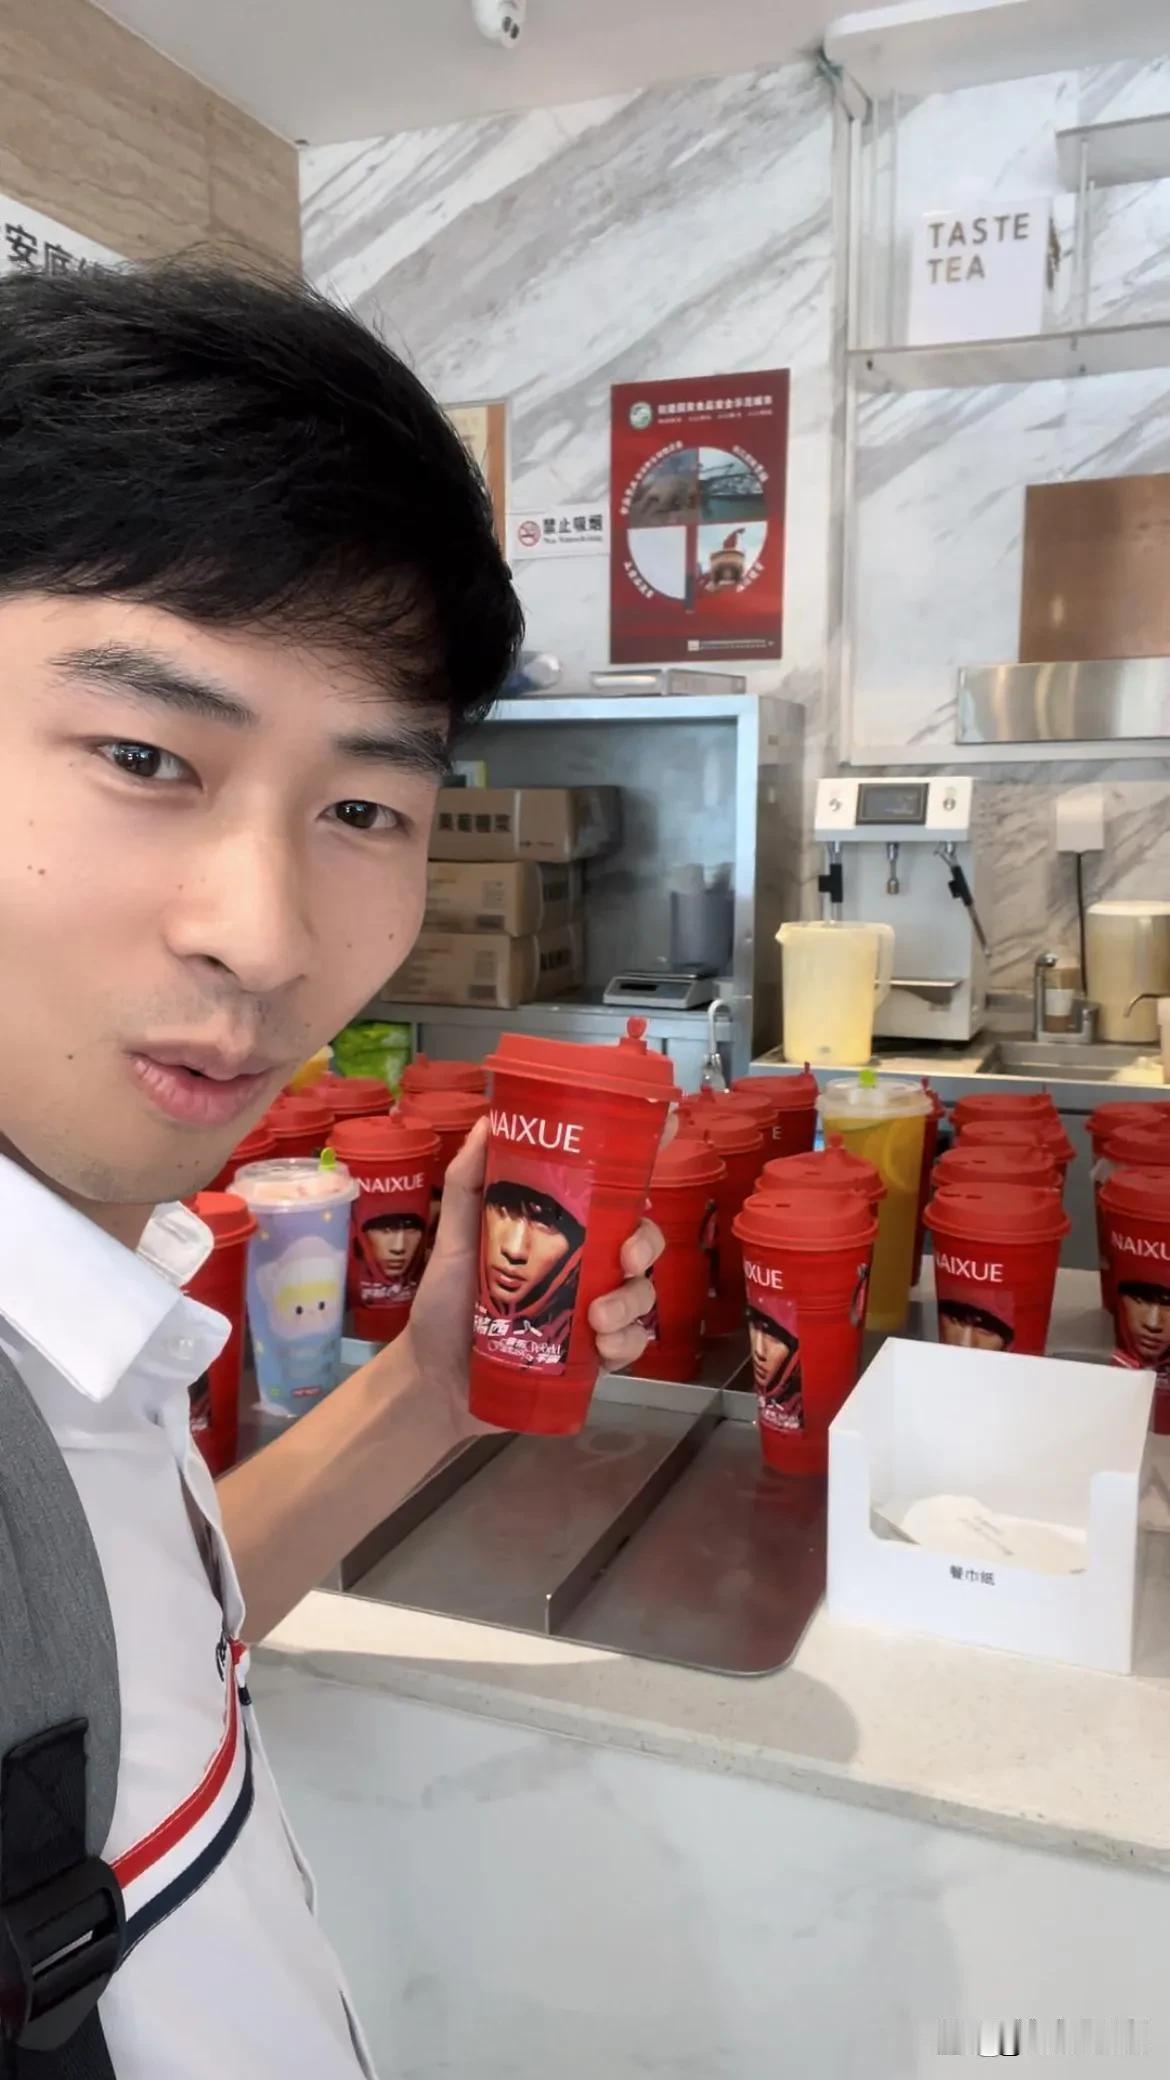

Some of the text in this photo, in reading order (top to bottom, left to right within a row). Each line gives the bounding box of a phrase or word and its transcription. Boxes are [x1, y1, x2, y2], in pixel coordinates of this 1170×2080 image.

[928, 212, 1030, 248] TASTE
[927, 254, 985, 284] TEA
[489, 1108, 585, 1154] NAIXUE
[357, 1172, 425, 1193] NAIXUE
